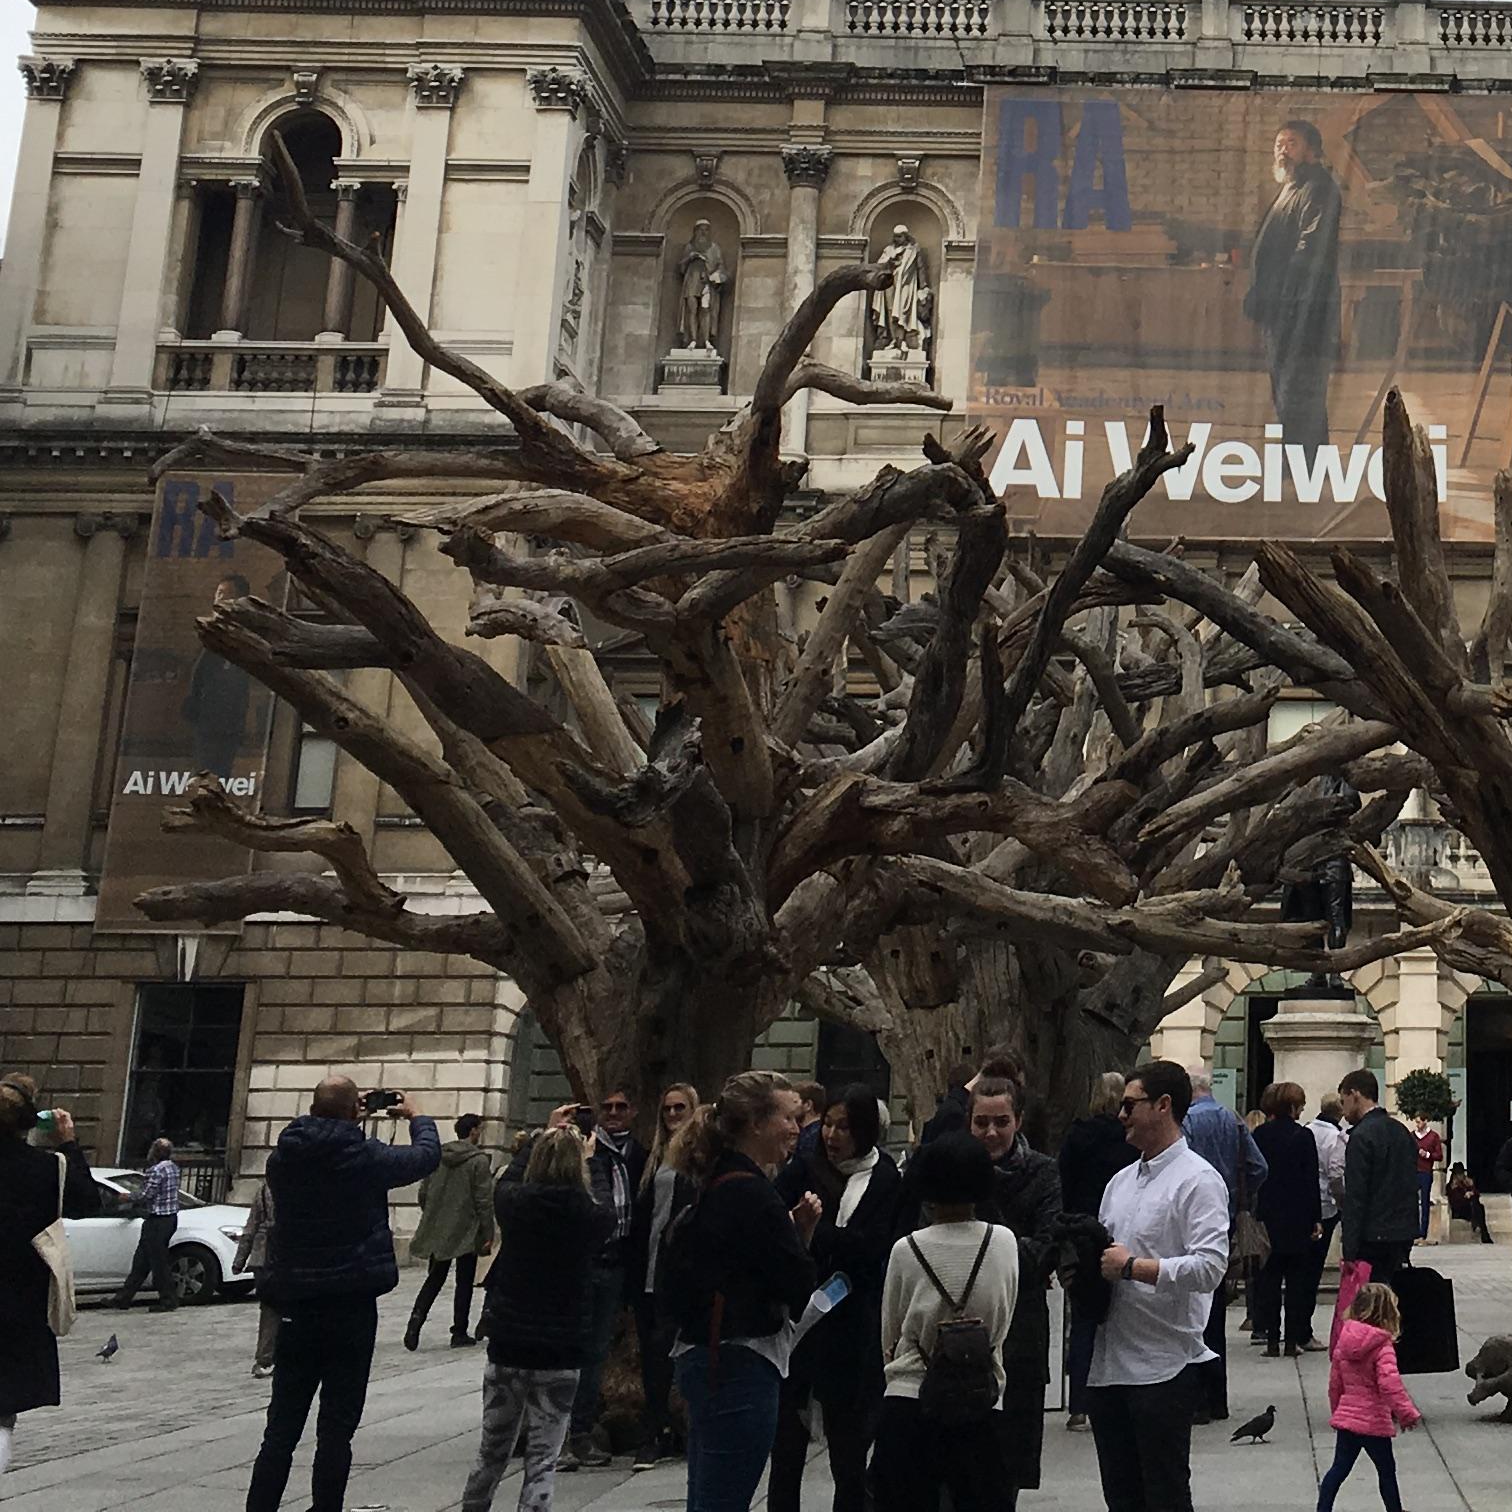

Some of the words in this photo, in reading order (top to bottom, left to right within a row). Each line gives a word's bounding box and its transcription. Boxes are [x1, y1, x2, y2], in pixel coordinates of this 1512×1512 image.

[994, 99, 1132, 232] RA
[985, 387, 1045, 410] Royal
[990, 418, 1086, 500] Ai
[122, 770, 155, 795] Ai
[159, 770, 257, 796] Wwei
